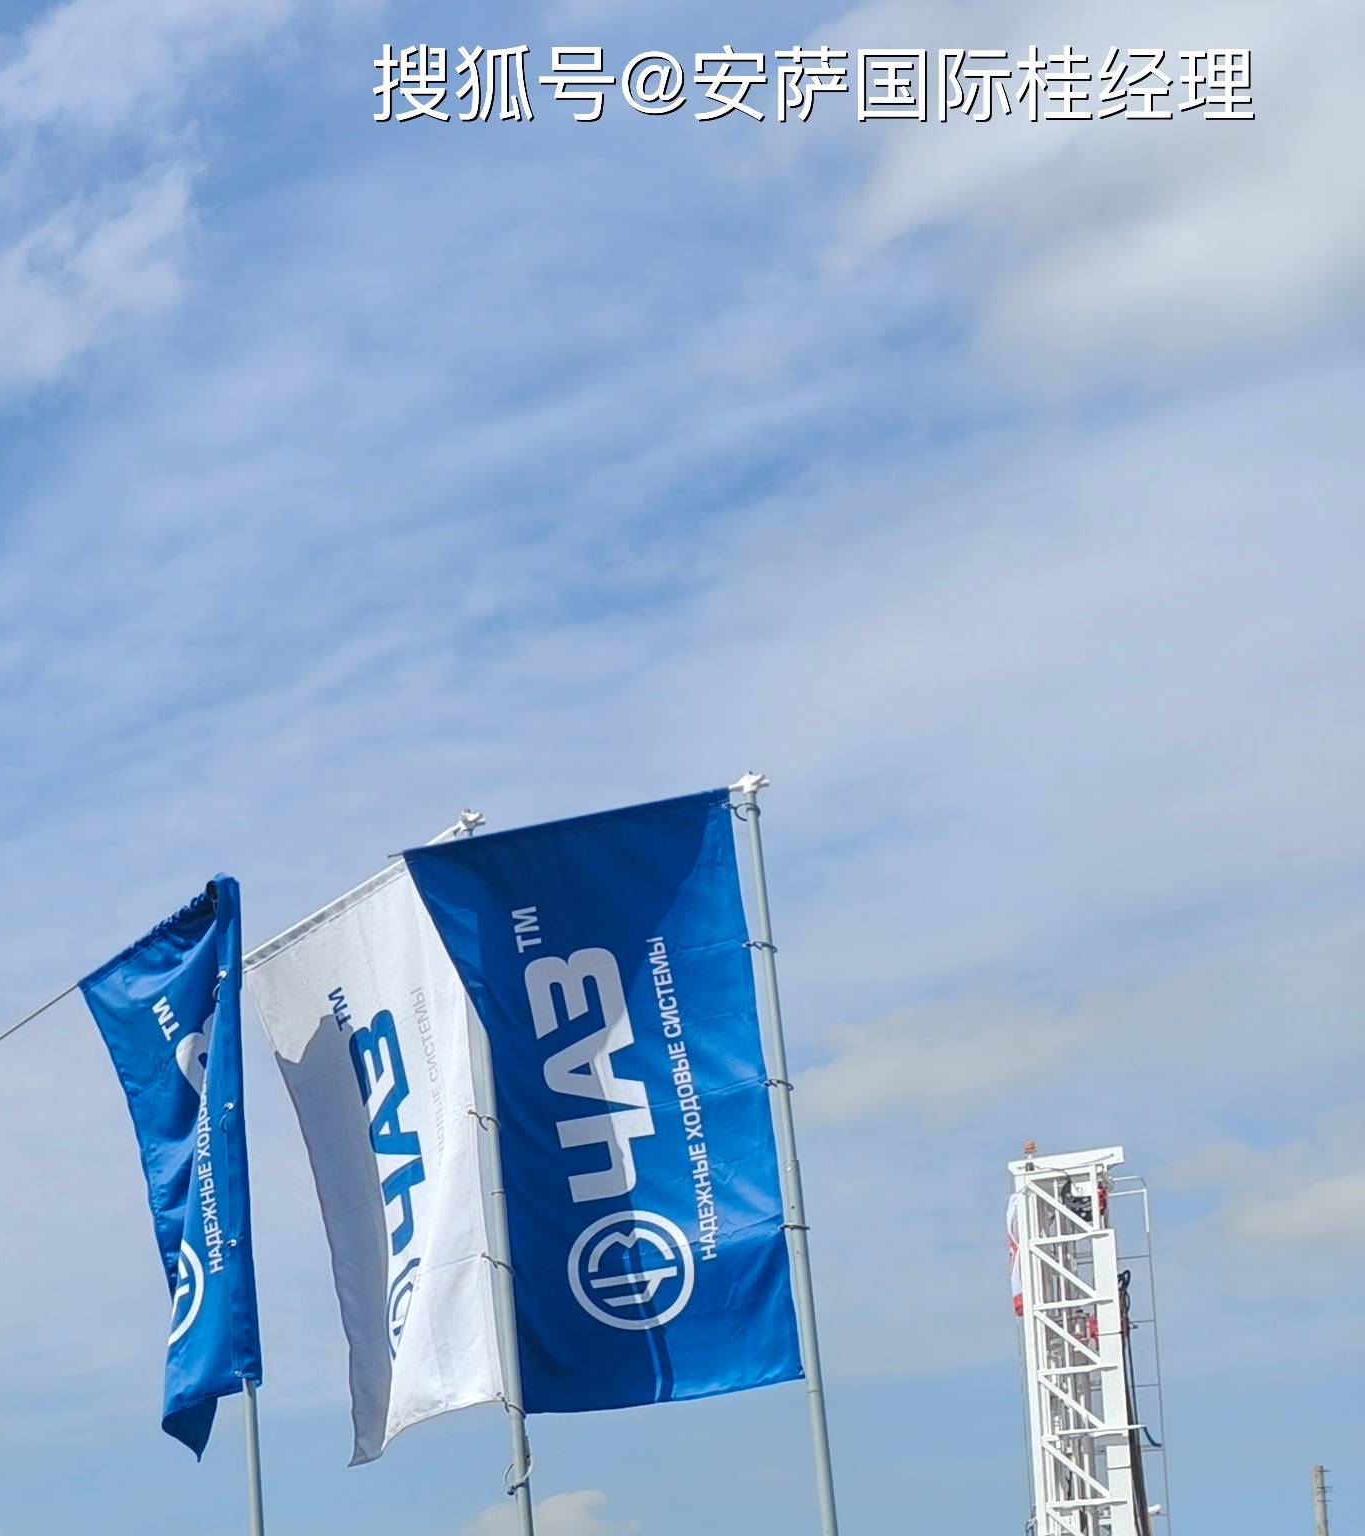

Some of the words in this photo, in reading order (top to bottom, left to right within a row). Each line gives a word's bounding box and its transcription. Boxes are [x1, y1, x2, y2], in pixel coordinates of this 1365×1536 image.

[645, 935, 683, 1039] СИСТЕМЫ
[348, 1007, 426, 1256] ЧАЗ
[524, 946, 656, 1204] ЧАЗ
[668, 1040, 704, 1140] ХОДОВЫЕ
[197, 1158, 225, 1275] НАДЕЖНЫЕ
[687, 1139, 719, 1262] НАДЕЖНЫЕ
